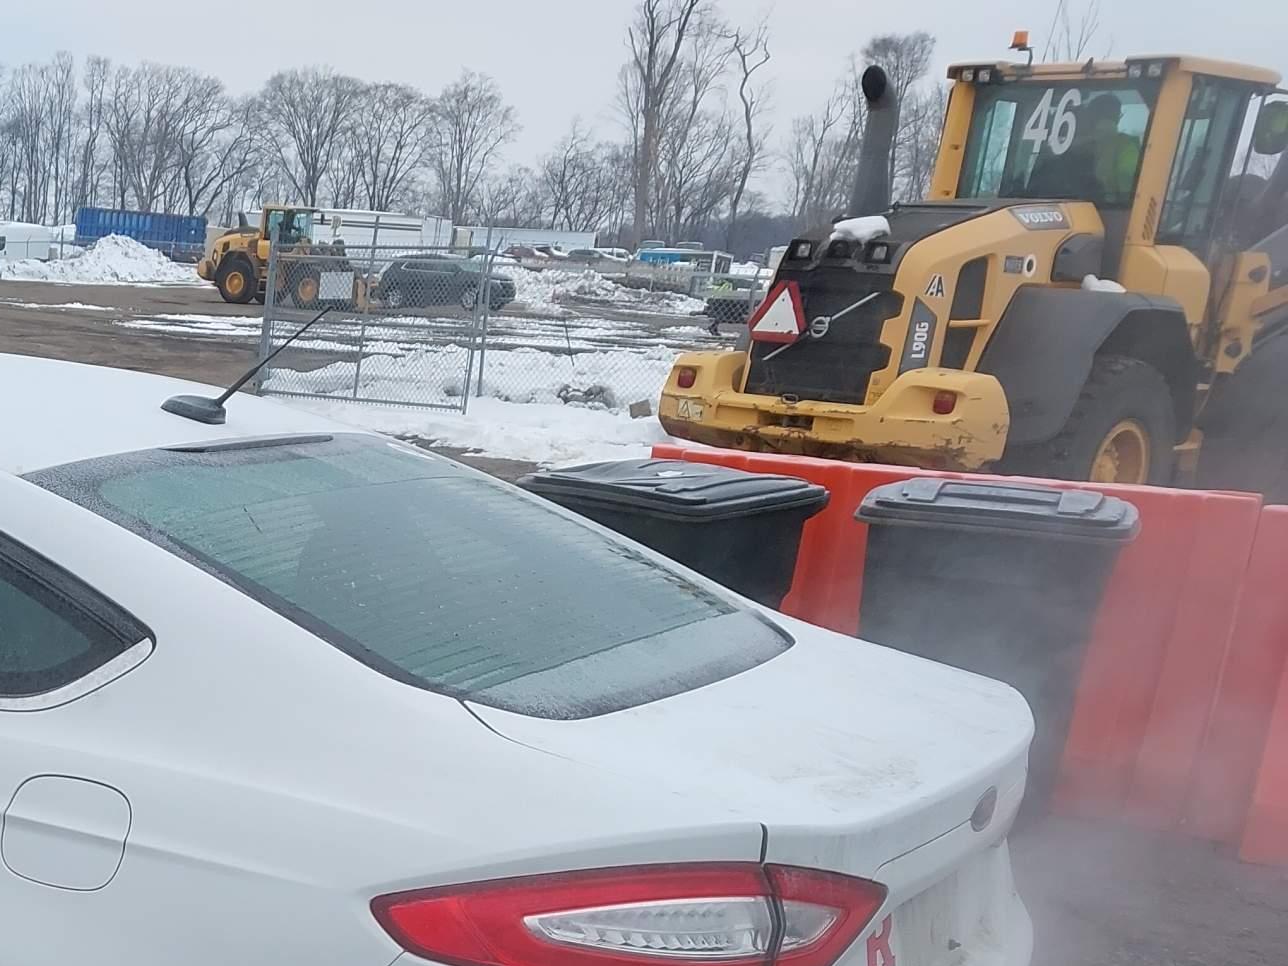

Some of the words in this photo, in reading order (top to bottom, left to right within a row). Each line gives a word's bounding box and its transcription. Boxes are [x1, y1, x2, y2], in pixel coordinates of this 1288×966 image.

[1022, 87, 1082, 156] 46
[1017, 210, 1064, 224] VOLVO
[910, 321, 929, 359] L90G
